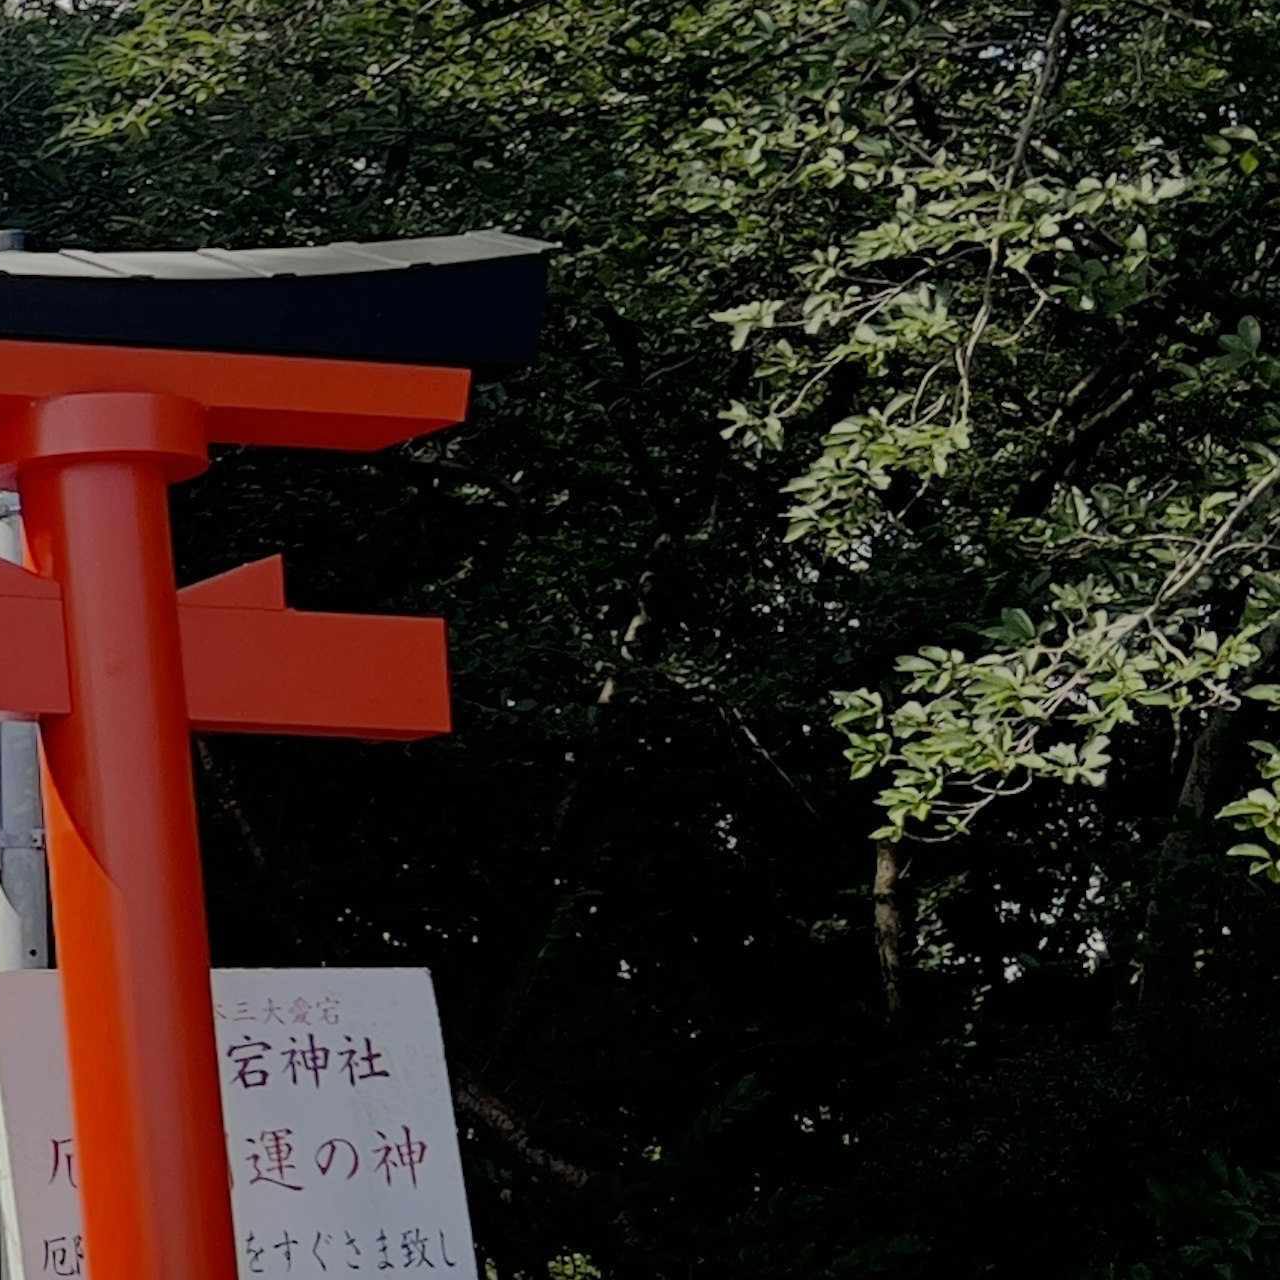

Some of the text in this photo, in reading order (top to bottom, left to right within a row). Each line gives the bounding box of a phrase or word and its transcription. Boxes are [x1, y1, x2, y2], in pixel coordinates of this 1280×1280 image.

[226, 1034, 390, 1088] 宕神社
[228, 1125, 428, 1190] 運の神
[245, 1229, 457, 1273] をすぐさま致し
